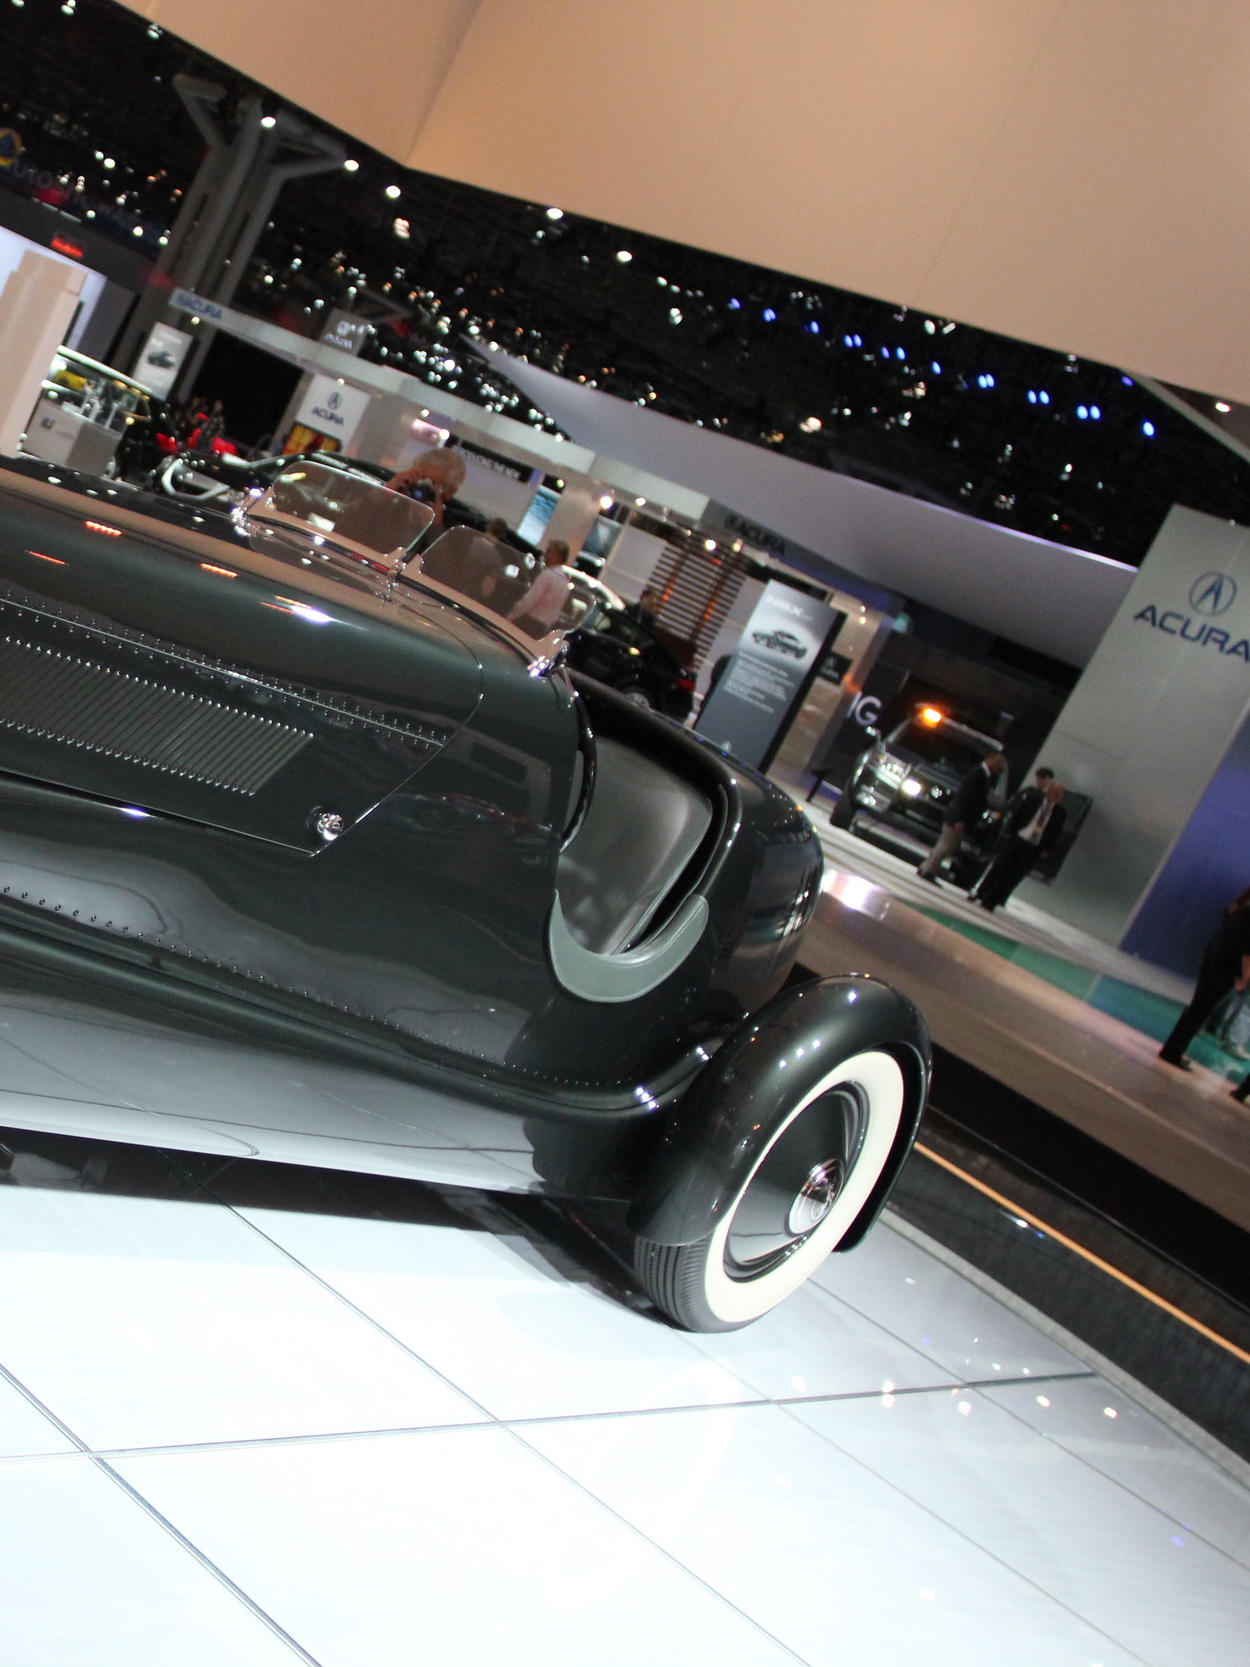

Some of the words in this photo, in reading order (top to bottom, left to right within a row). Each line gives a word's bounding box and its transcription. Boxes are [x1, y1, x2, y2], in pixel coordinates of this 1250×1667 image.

[311, 405, 344, 426] ACURA
[738, 520, 786, 554] ACURA
[1133, 603, 1250, 663] ACURA
